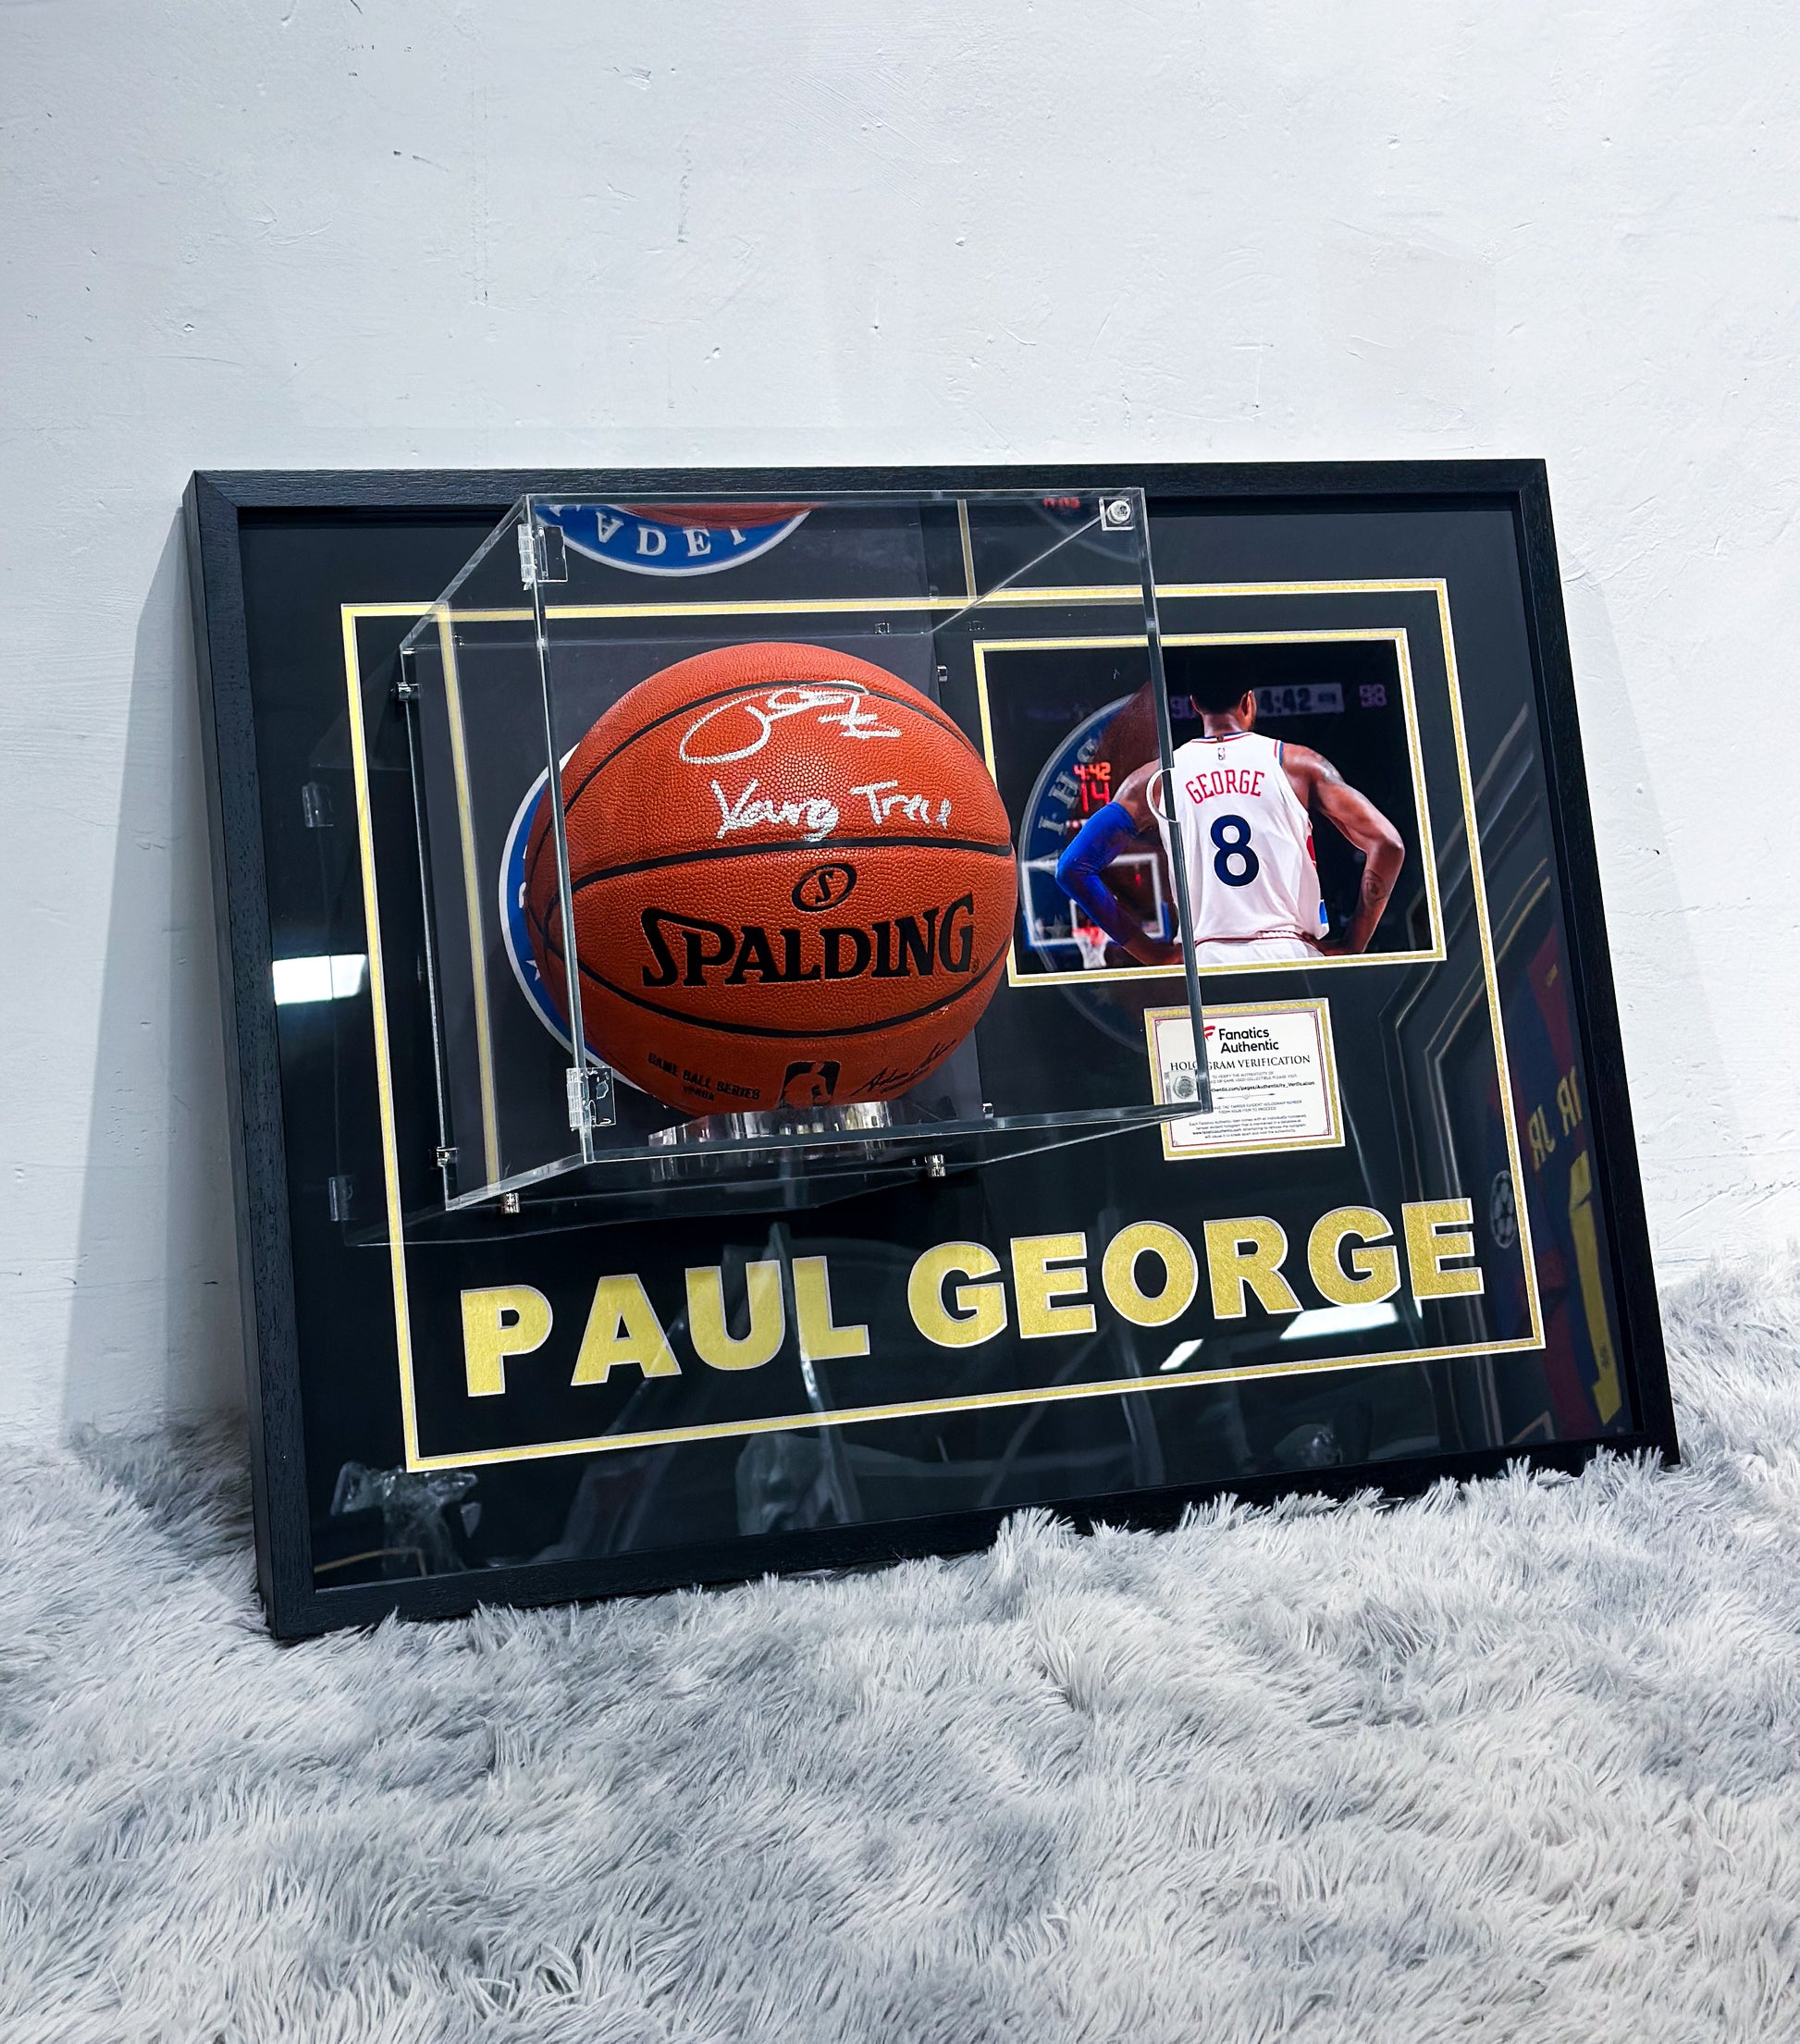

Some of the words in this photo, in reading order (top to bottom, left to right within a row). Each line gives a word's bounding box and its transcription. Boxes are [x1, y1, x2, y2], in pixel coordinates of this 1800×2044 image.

[1073, 762, 1111, 782] 4:42
[1185, 769, 1265, 805] GEORGE
[1210, 814, 1260, 887] 8
[641, 893, 974, 988] SPALDING
[1218, 1027, 1270, 1040] Fanatics
[1220, 1039, 1279, 1053] Authentic
[1237, 1054, 1311, 1068] VERIFICATION
[461, 1255, 870, 1398] PAUL
[907, 1198, 1485, 1348] GEORGE
